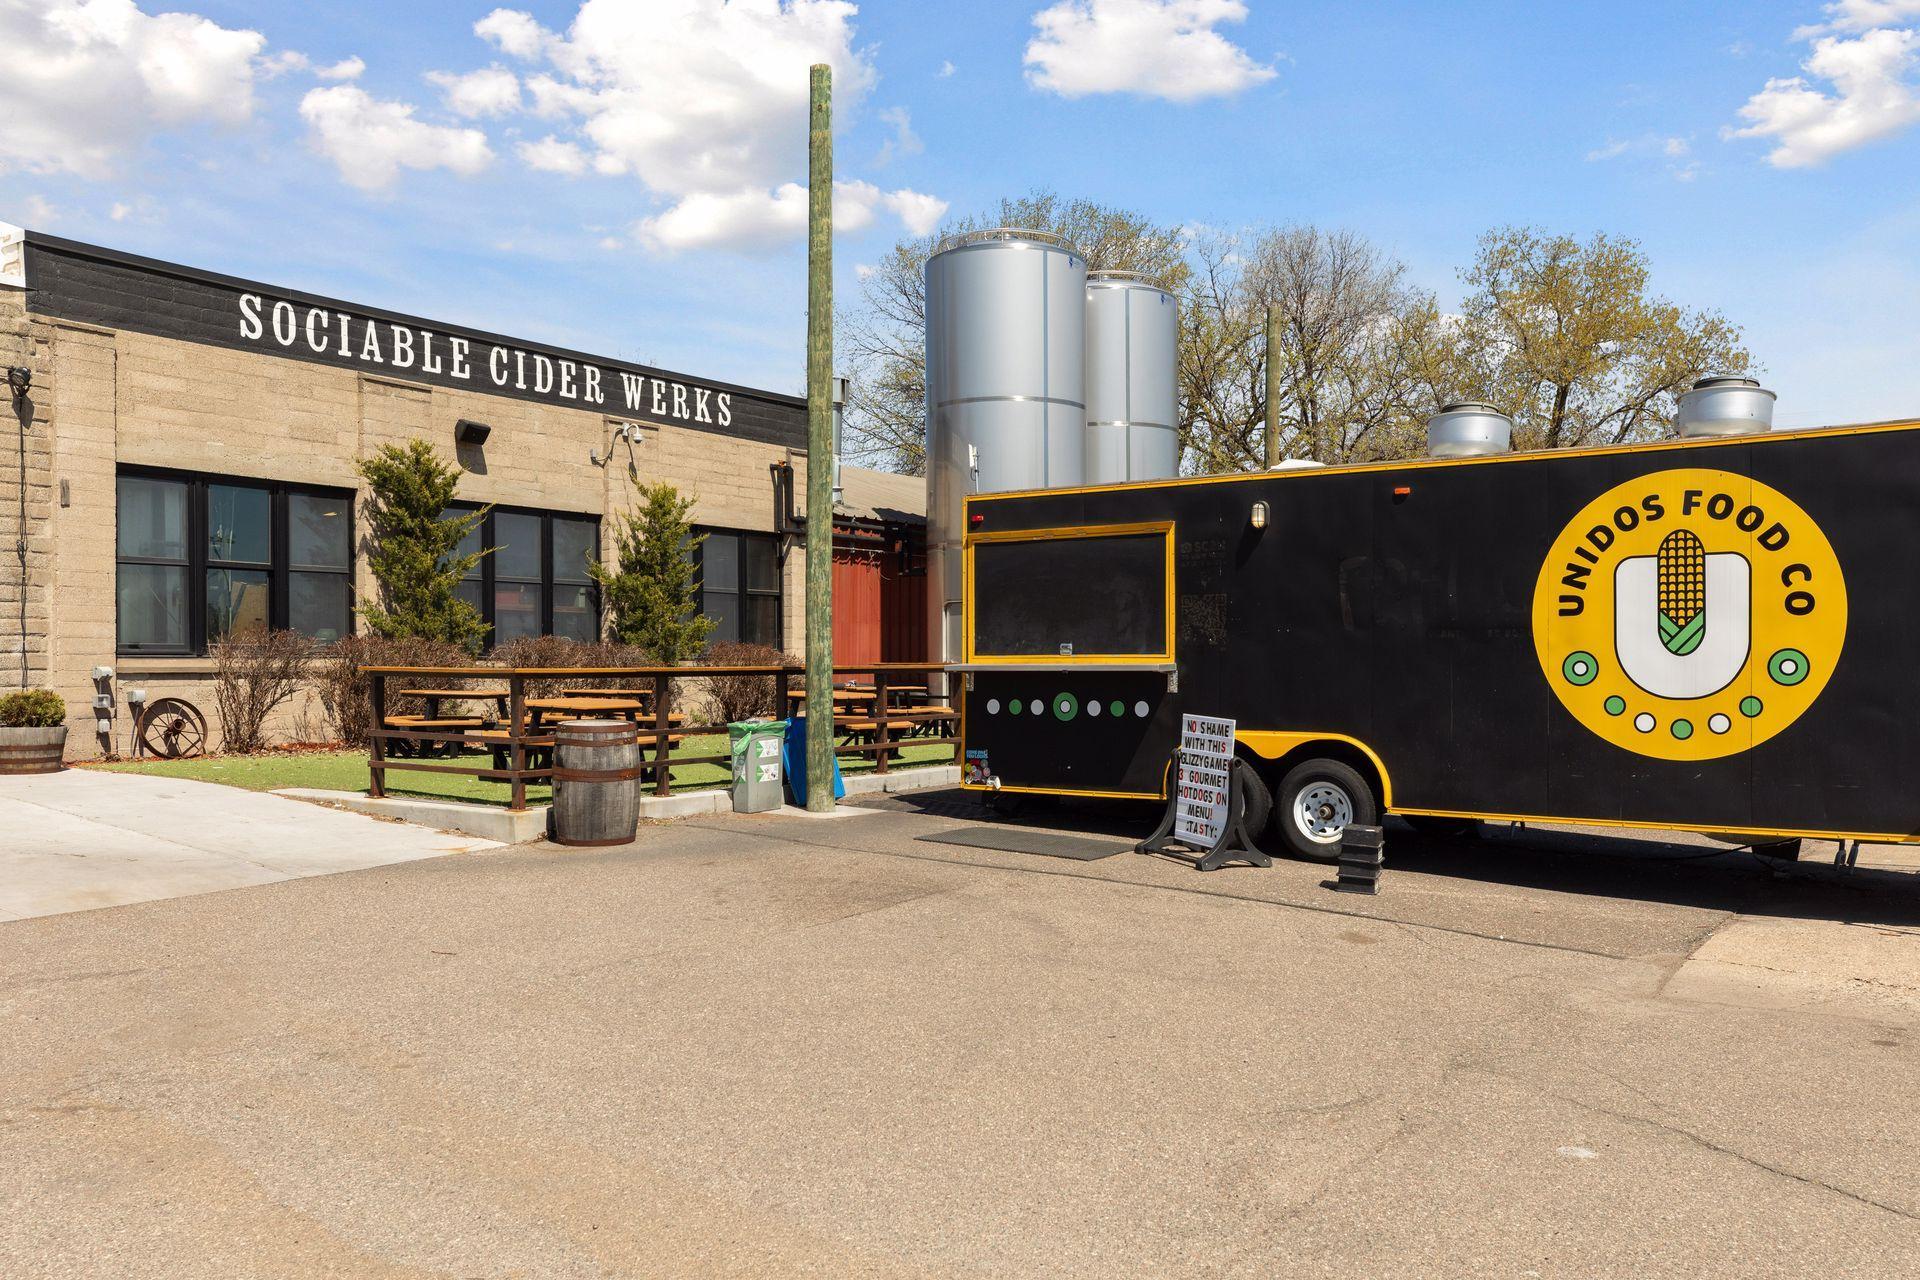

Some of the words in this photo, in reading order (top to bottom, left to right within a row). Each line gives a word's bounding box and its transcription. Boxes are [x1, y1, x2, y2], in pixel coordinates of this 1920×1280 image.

[239, 293, 471, 379] SOCIABLE
[489, 346, 604, 404] CIDER
[620, 372, 732, 427] WERKS
[1558, 494, 1665, 617] UNIDOS
[1682, 490, 1790, 551] FOOD
[1781, 563, 1816, 616] CO
[1187, 720, 1197, 733] NO
[1201, 722, 1229, 737] SHAME
[1184, 736, 1205, 751] WITH
[1208, 740, 1226, 753] THIS
[1178, 768, 1184, 781] 3
[1190, 771, 1227, 788] GOURMET
[1178, 786, 1213, 803] HOTDOGS
[1216, 792, 1227, 806] ON
[1188, 804, 1213, 820] MENU!
